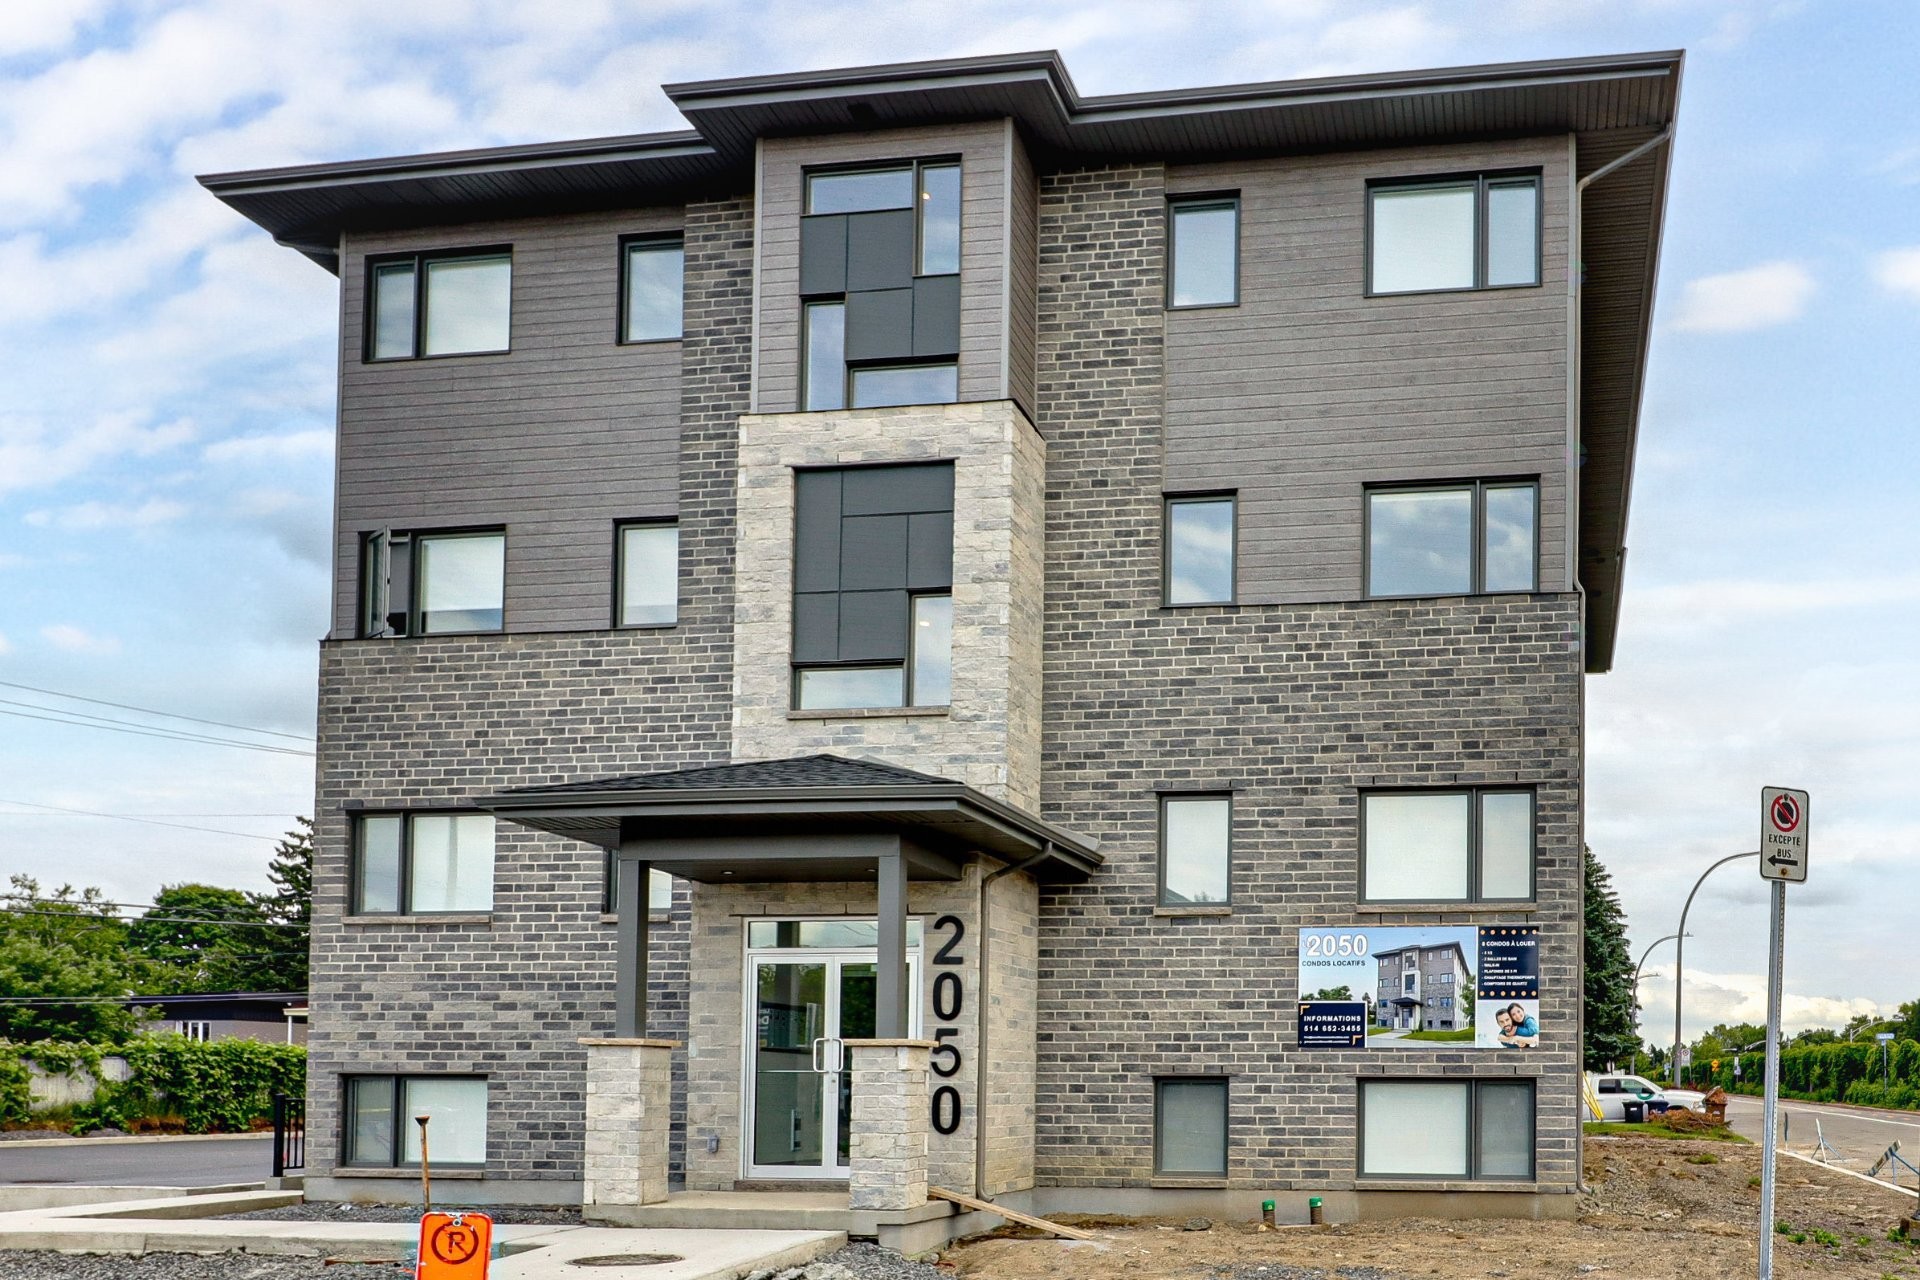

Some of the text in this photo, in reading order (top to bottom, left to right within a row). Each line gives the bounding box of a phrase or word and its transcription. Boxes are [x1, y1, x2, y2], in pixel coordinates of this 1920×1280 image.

[1776, 848, 1792, 858] BUS
[1306, 934, 1368, 957] 2050
[931, 915, 965, 1135] 2050
